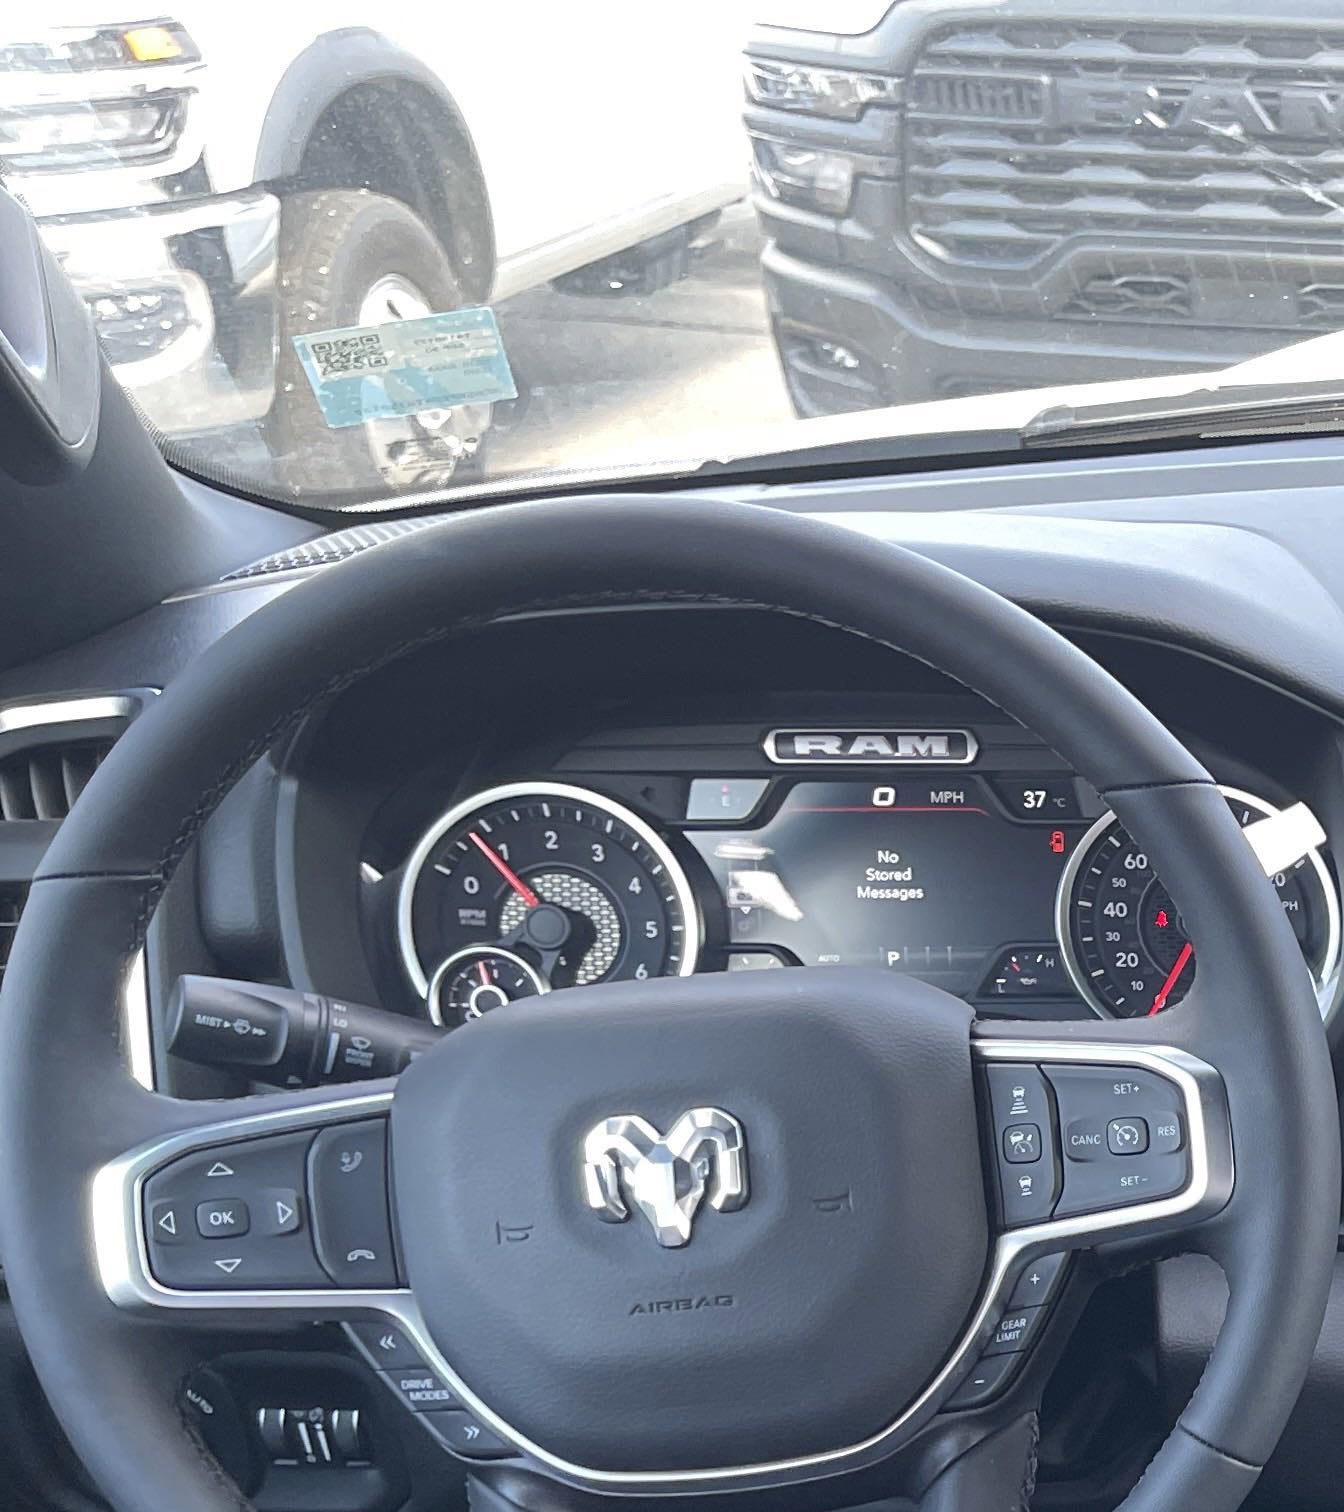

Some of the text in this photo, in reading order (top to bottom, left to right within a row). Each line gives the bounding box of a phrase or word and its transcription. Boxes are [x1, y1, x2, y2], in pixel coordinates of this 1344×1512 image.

[793, 735, 950, 757] RAM
[930, 791, 964, 805] MPH
[1023, 791, 1046, 809] 37
[545, 831, 559, 850] 2
[592, 844, 605, 863] 3
[878, 851, 899, 864] No
[1124, 853, 1148, 870] 60
[866, 868, 912, 882] Stored
[1112, 877, 1127, 888] 50
[464, 877, 479, 895] 0
[628, 877, 642, 894] 4
[857, 886, 924, 902] Messages
[1103, 902, 1128, 918] 40
[1280, 901, 1299, 911] PH
[645, 922, 658, 939] 5
[1105, 932, 1121, 942] 30
[887, 951, 900, 966] P
[1045, 958, 1055, 968] H
[1115, 952, 1139, 968] 20
[635, 964, 648, 981] 6
[1130, 981, 1144, 991] 10
[195, 1013, 223, 1029] MIST
[1157, 1125, 1176, 1137] RES
[1071, 1134, 1101, 1147] CANC
[209, 1211, 234, 1226] OK
[628, 1294, 734, 1316] AIRBAG
[1001, 1318, 1026, 1330] GEAR
[996, 1329, 1021, 1342] LIMIT
[401, 1378, 434, 1390] DRIVE
[408, 1389, 450, 1401] MODES
